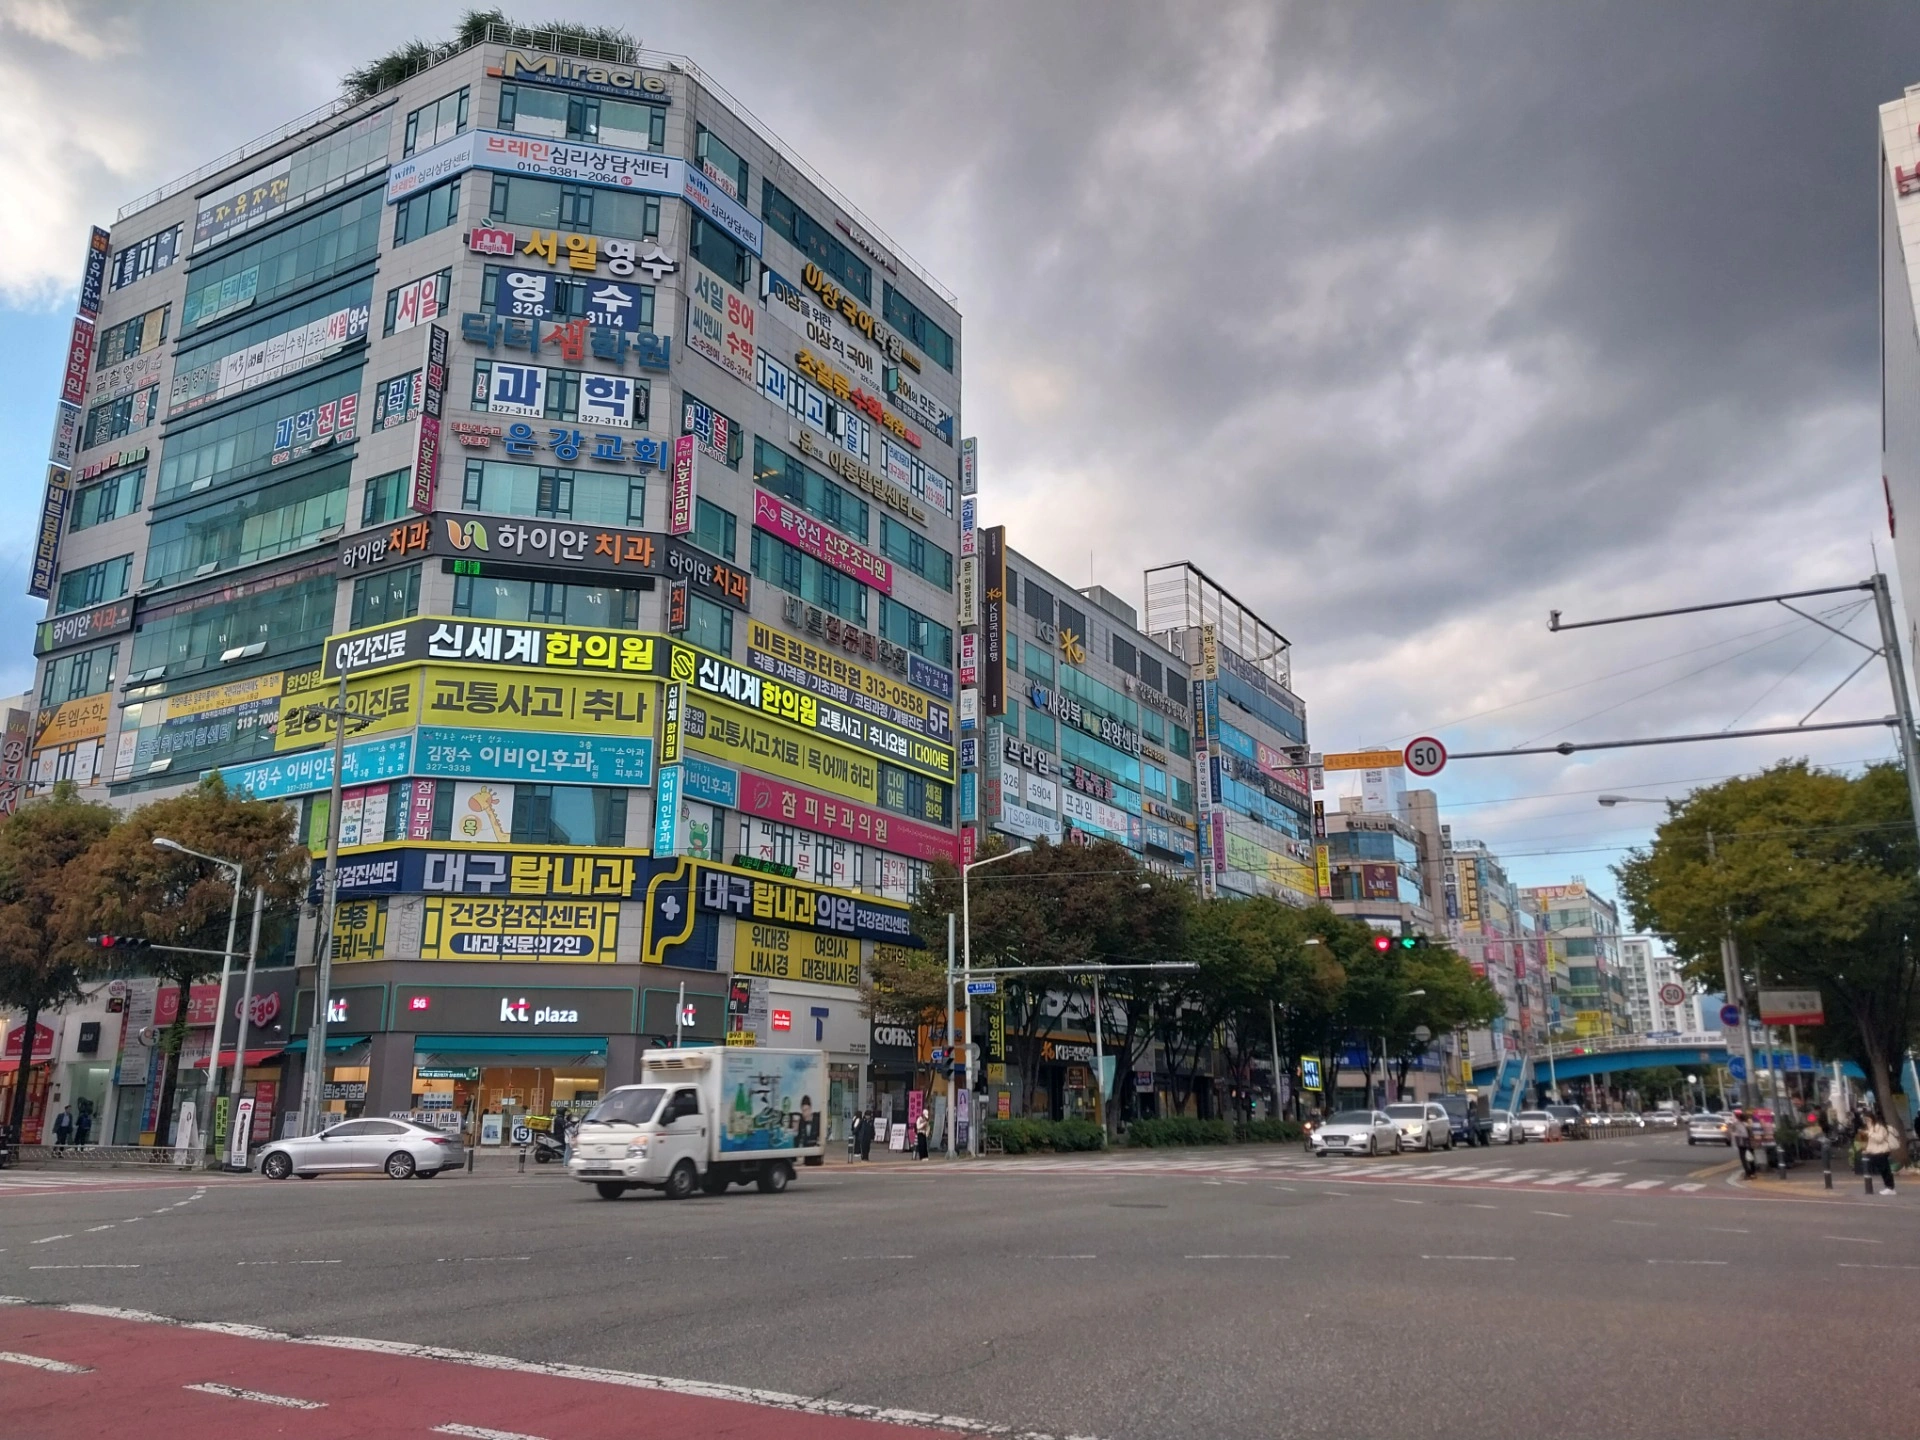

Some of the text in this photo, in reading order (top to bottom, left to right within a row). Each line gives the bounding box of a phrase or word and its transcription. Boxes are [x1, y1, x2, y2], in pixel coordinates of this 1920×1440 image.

[505, 50, 666, 94] Miracle
[393, 163, 416, 180] with
[516, 160, 618, 184] 010-9381-2064
[689, 174, 709, 195] with
[479, 243, 505, 253] English
[397, 279, 438, 325] 서일
[694, 271, 724, 315] 서일
[775, 280, 832, 331] 이상을 위한
[693, 305, 723, 347] 씨앤씨
[728, 294, 754, 337] 영어
[460, 311, 672, 370] 닥터샘학원
[726, 331, 754, 367] 수학
[806, 321, 845, 359] 이상적
[491, 404, 541, 418] 327-3114
[581, 414, 630, 428] 327-3114
[503, 422, 668, 472] 은강교회
[674, 458, 693, 526] 산후조리원
[779, 506, 887, 583] 류정선 산후조리원
[335, 629, 407, 670] 야간진료
[754, 651, 775, 673] 각종
[754, 625, 924, 715] 비트컴퓨터학원 313-0558
[431, 679, 648, 724] 교통사고 추나
[236, 710, 280, 731] 313-7006
[665, 685, 679, 758] 신세계한의원
[929, 704, 949, 734] 5F
[579, 740, 593, 750] 3층
[615, 747, 646, 757] 소아과
[820, 707, 861, 740] 교통사고
[869, 726, 908, 758] 추나요법
[914, 743, 950, 772] 다이어트
[425, 762, 472, 773] 327-3338
[427, 745, 473, 763] 김정수
[479, 746, 595, 774] 이비인후과
[807, 747, 874, 791] 목 어깨 허리
[1006, 737, 1050, 776] 프라임
[1413, 747, 1437, 766] 50
[242, 769, 283, 793] 김정수
[411, 781, 435, 841] 참피부과
[659, 779, 674, 844] 이비인후과
[782, 789, 889, 845] 참피부과의원
[1065, 793, 1093, 821] 프라임
[463, 818, 478, 837] 목
[449, 902, 597, 930] 건강검진센터
[751, 925, 791, 952] 위대장
[814, 935, 850, 960] 여의사
[750, 951, 790, 977] 내시경
[801, 958, 860, 986] 대장내시경
[111, 985, 126, 993] BAR
[1665, 989, 1680, 1000] 50
[327, 998, 348, 1022] kt
[412, 998, 427, 1010] 5G
[500, 998, 579, 1026] kt plaza
[415, 1112, 435, 1124] 특판
[440, 1112, 458, 1123] 세일
[514, 1127, 529, 1140] 15
